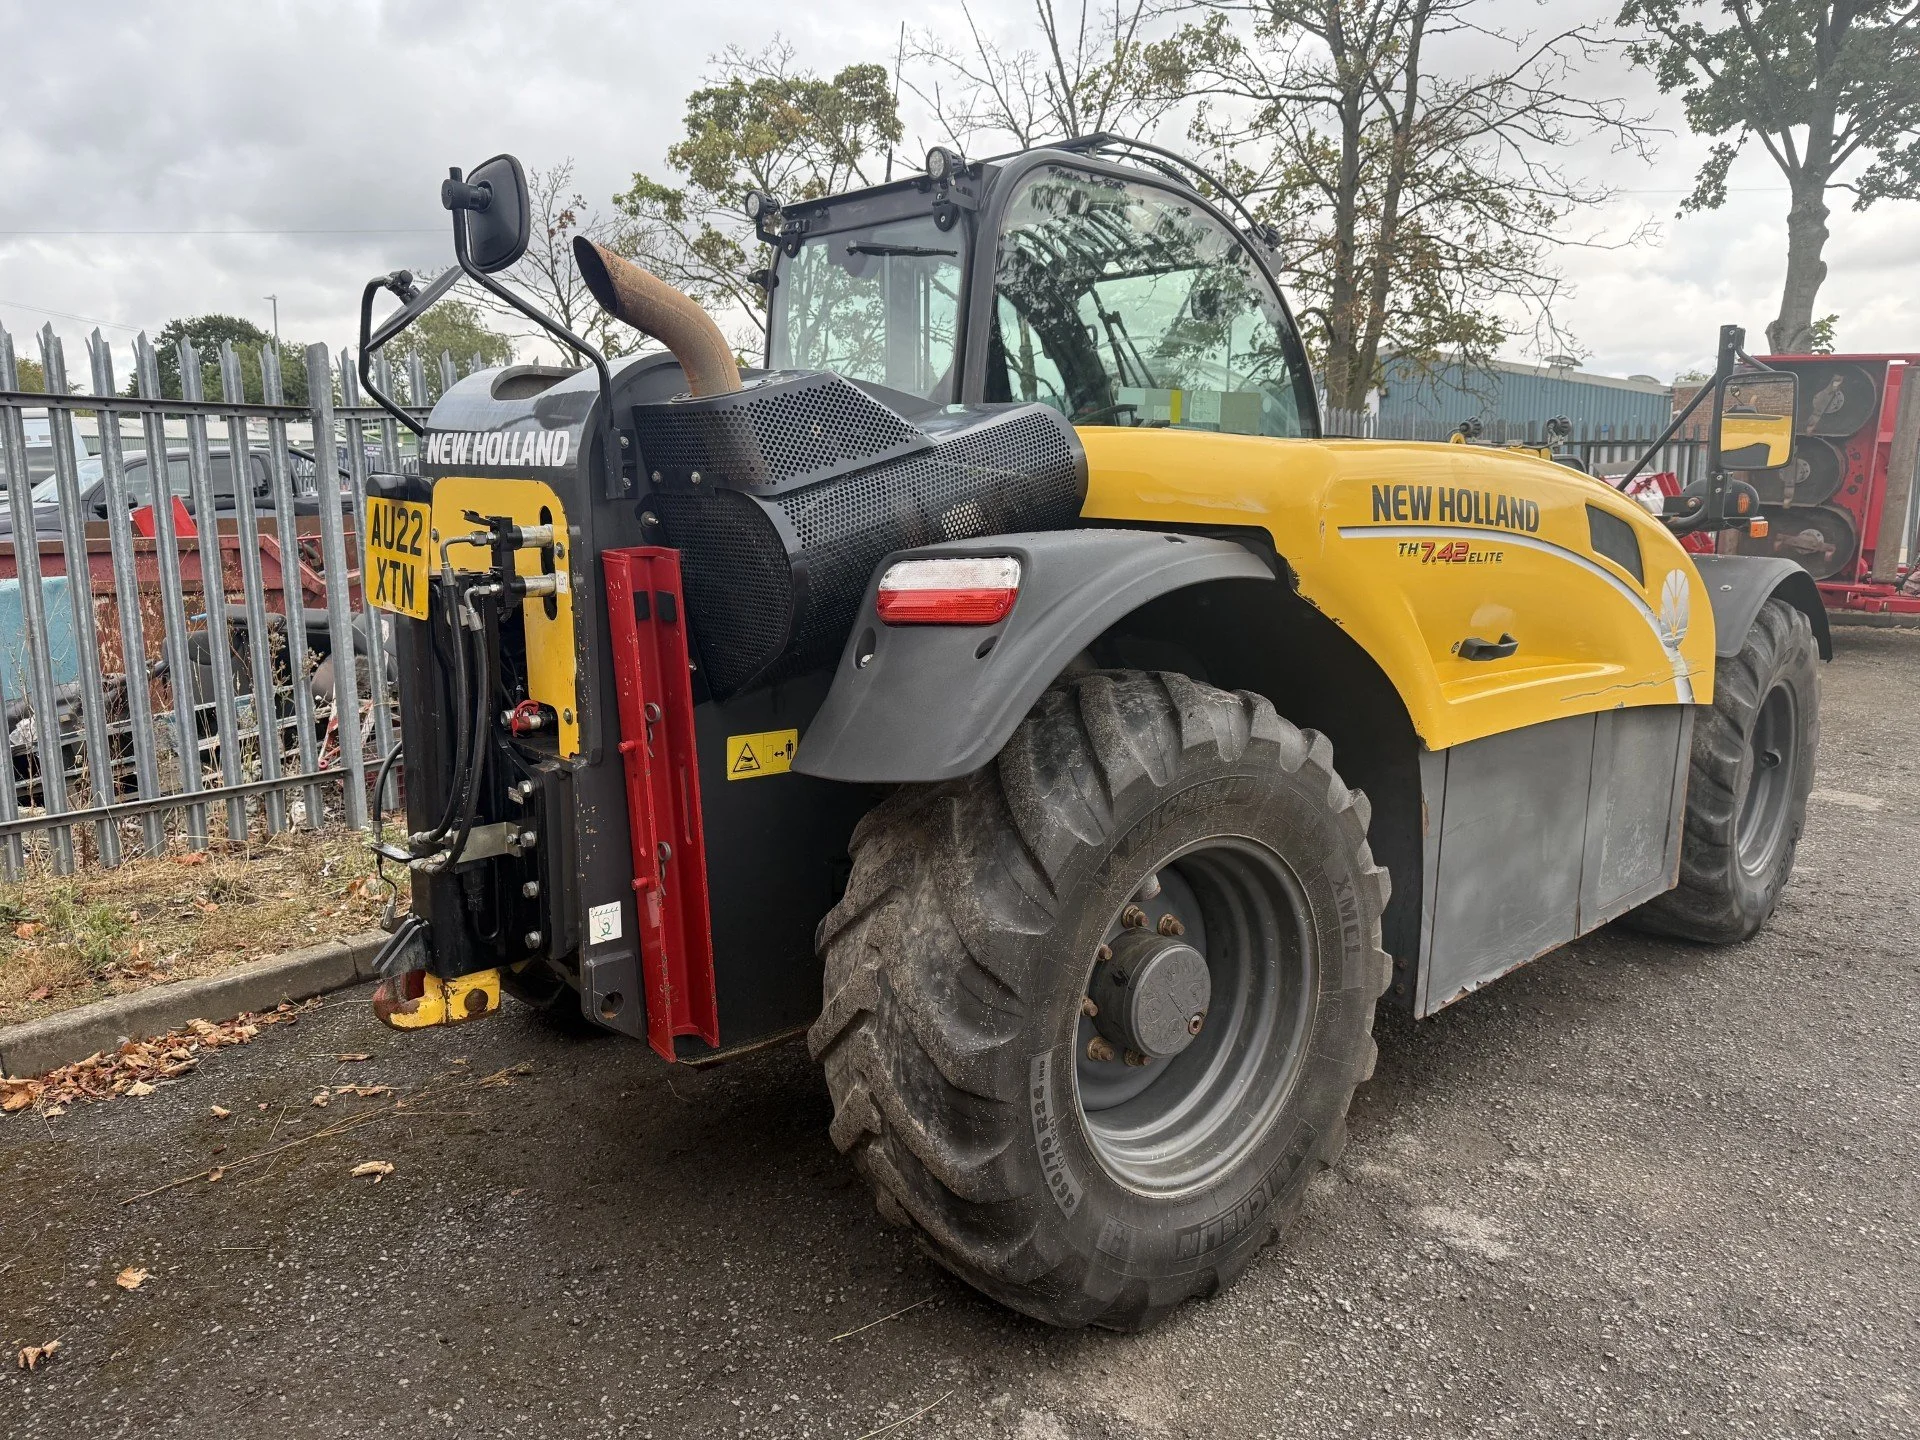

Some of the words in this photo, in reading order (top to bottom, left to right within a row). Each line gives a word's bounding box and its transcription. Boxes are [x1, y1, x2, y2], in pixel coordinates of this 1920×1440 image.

[427, 431, 472, 465] NEW
[471, 430, 570, 467] HOLLAND
[371, 503, 423, 556] AU22
[1371, 484, 1433, 522] NEW
[1438, 486, 1540, 533] HOLLAND
[1398, 542, 1420, 556] TH
[1420, 541, 1469, 564] 7.42
[1468, 551, 1504, 563] ELITE
[375, 556, 415, 610] XTN
[1033, 1085, 1049, 1134] R24
[1040, 1136, 1076, 1209] 460/70
[1174, 1152, 1291, 1260] MICHELIN
